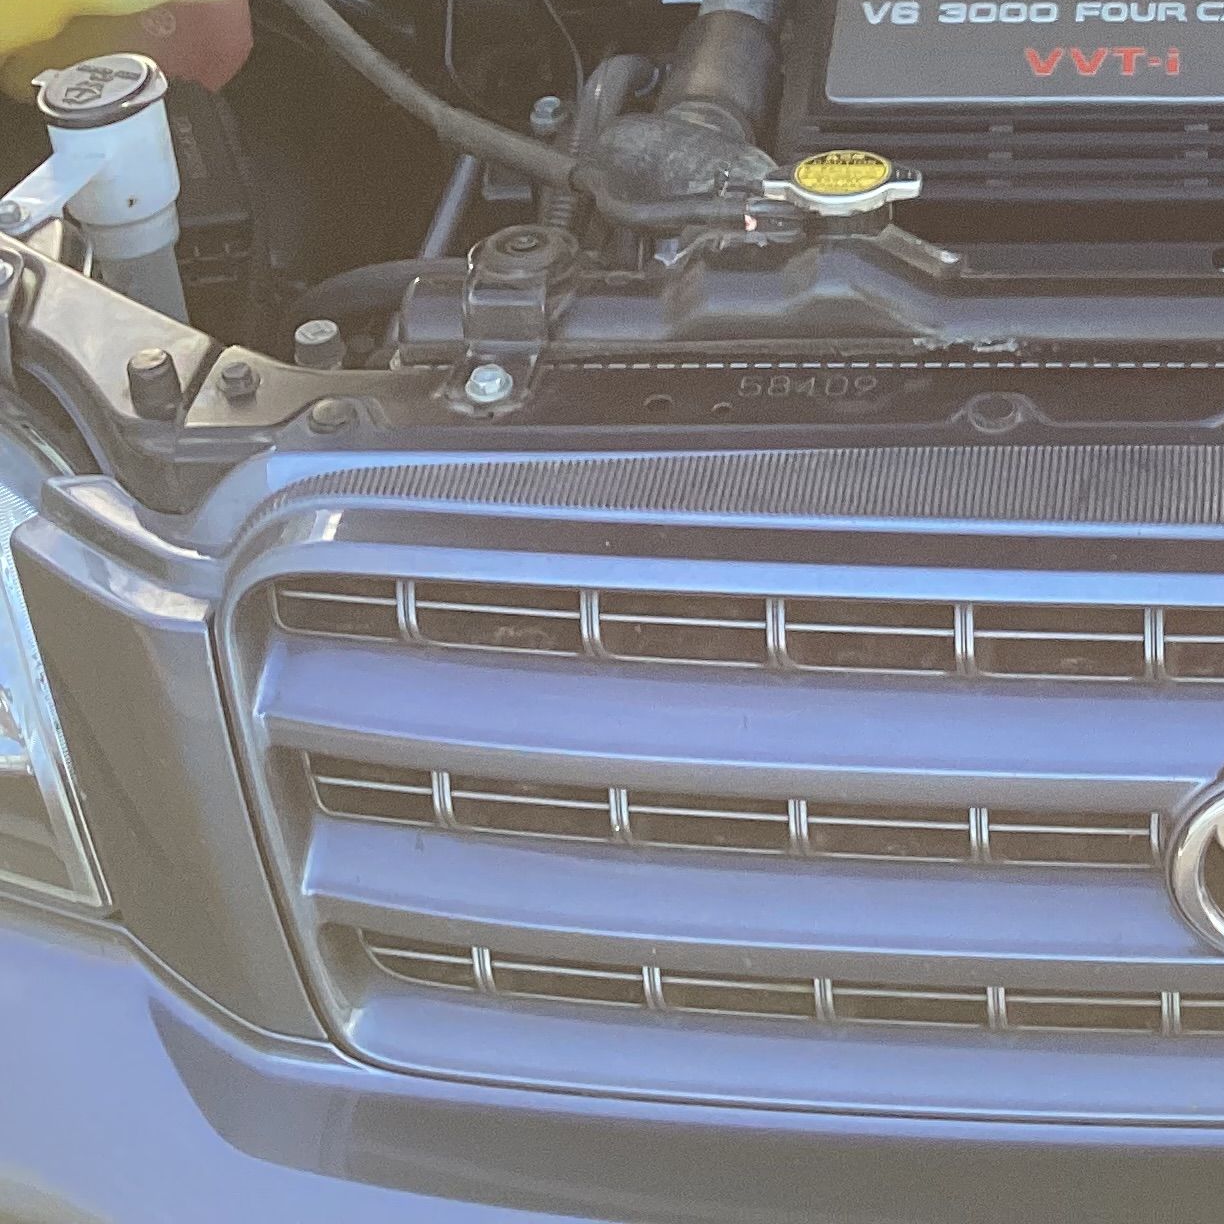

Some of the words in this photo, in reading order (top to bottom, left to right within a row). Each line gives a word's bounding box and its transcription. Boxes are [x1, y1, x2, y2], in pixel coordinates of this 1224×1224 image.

[862, 1, 920, 24] V6
[938, 1, 1059, 23] 3000
[1075, 1, 1188, 23] FOUR
[1024, 47, 1180, 75] VVT-i
